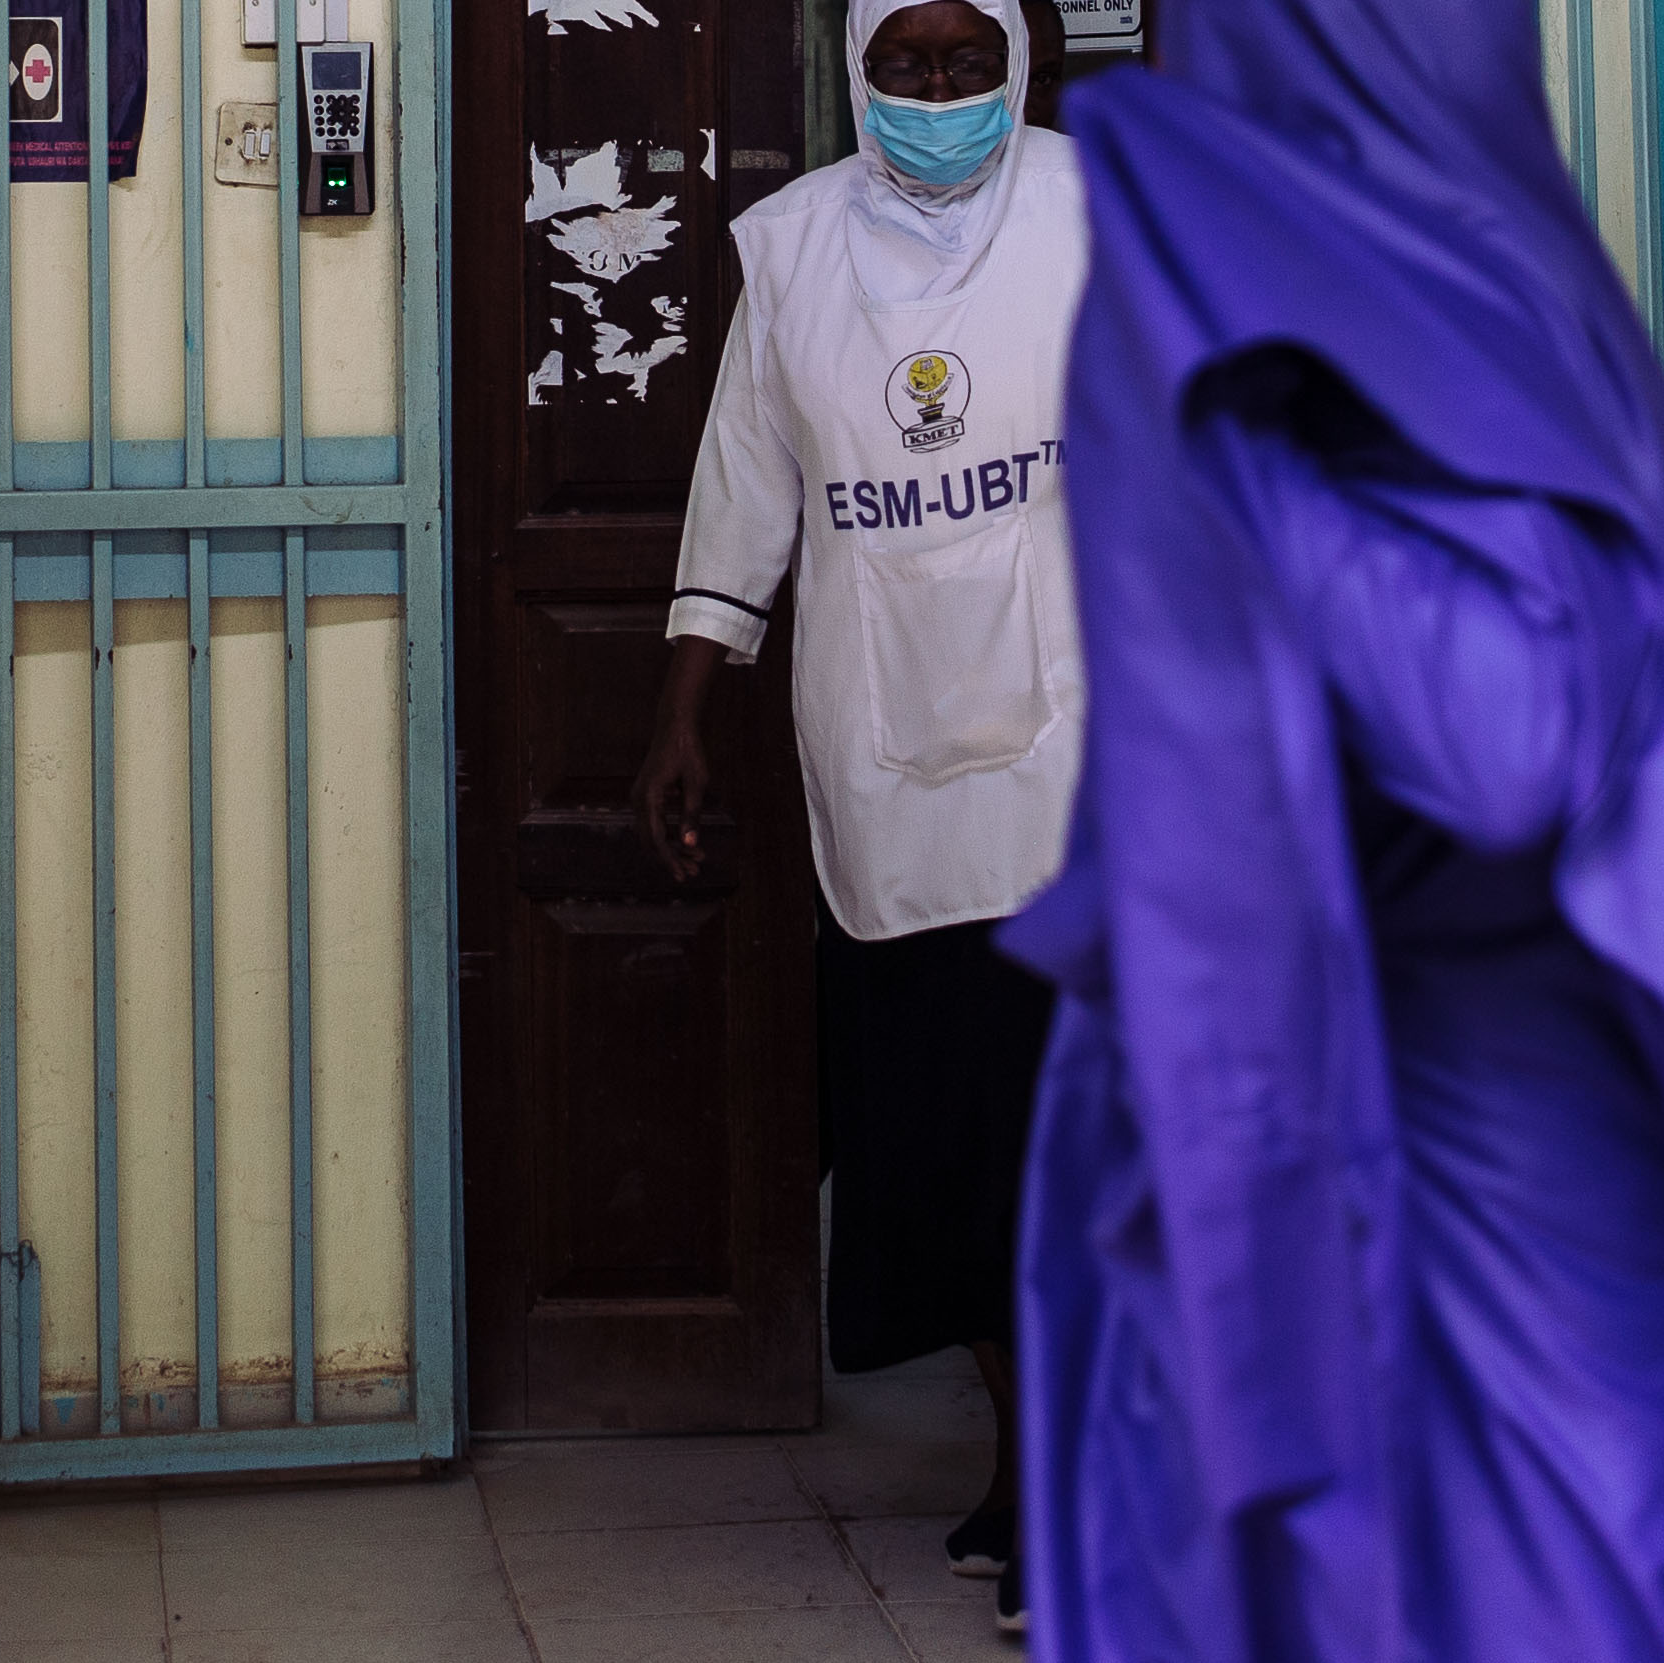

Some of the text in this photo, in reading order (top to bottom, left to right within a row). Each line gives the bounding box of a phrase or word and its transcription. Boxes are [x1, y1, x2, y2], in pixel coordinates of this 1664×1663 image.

[1055, 0, 1101, 14] SONNEL
[909, 424, 959, 444] KMET
[825, 451, 1040, 530] ESM-UBT
